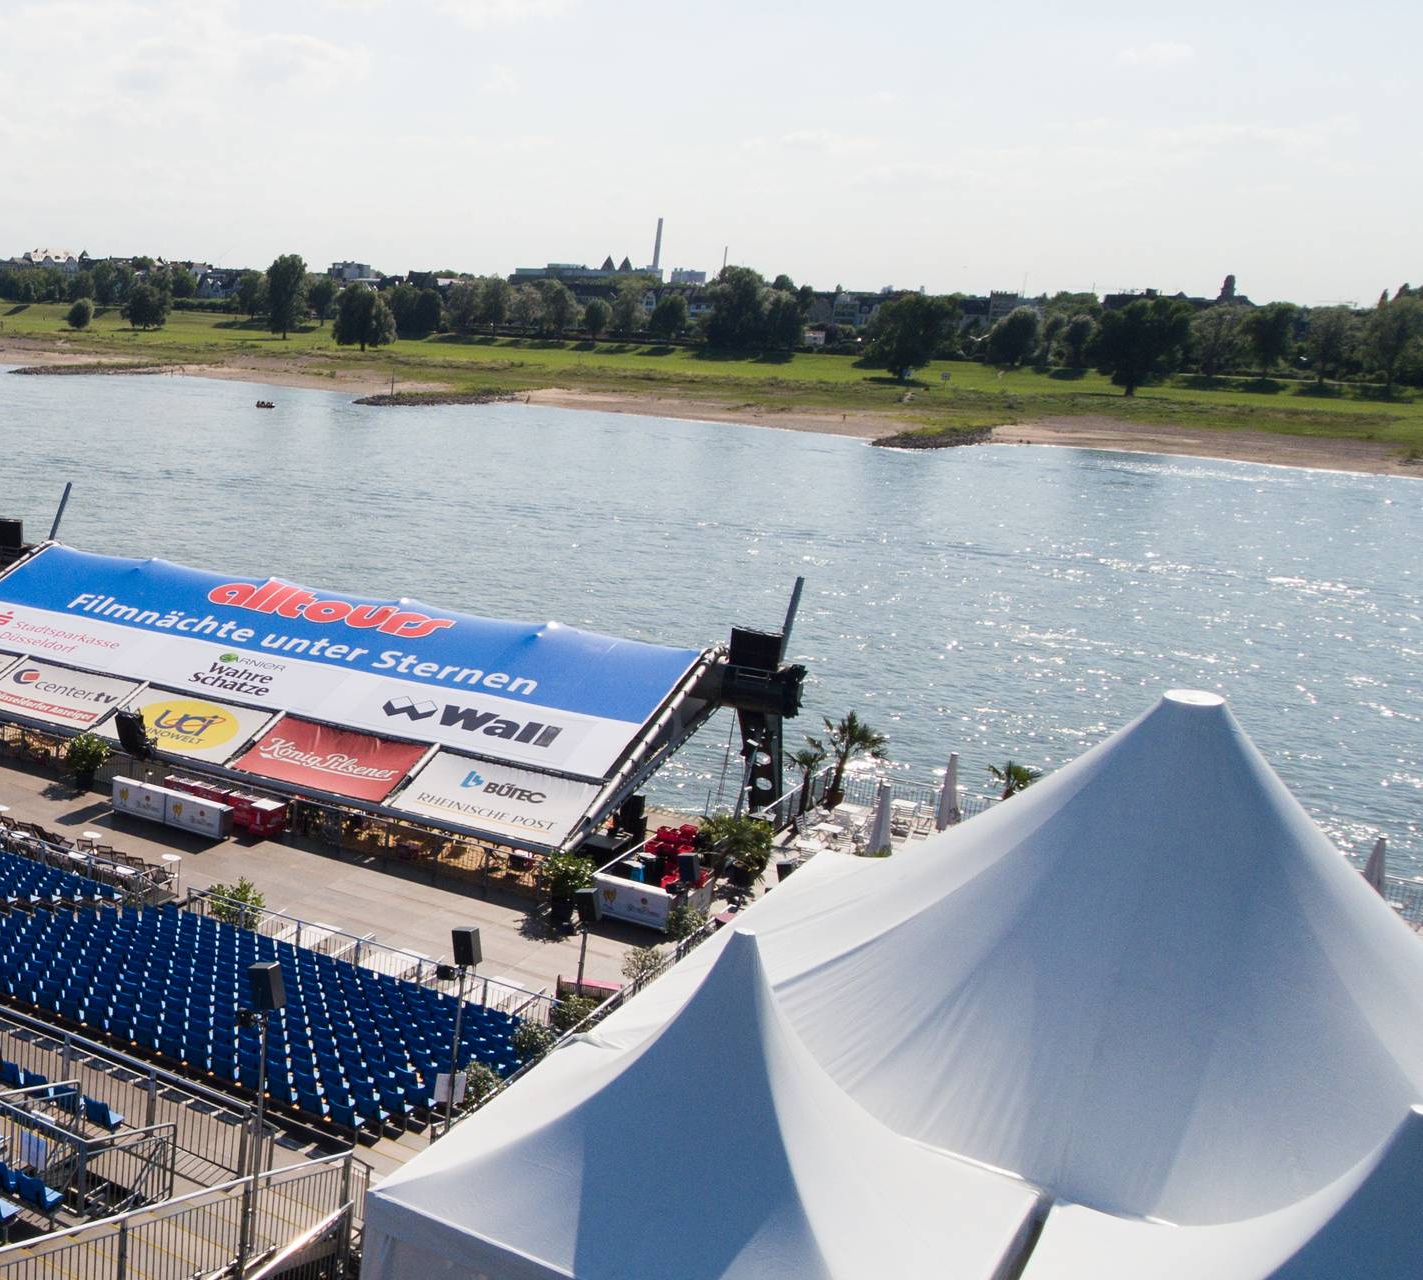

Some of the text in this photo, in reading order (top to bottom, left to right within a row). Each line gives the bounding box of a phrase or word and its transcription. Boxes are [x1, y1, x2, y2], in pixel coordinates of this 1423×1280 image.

[208, 579, 457, 639] alltours
[0, 631, 77, 656] Düsseldorf
[12, 621, 121, 650] Stadtsparkasse
[67, 593, 538, 697] Filmnächte unter Sternen
[34, 679, 119, 704] center.tv
[209, 662, 273, 684] Wahre
[439, 704, 563, 748] Wall
[260, 737, 400, 779] König Pilsener
[417, 791, 558, 831] RHEINISCHE POST
